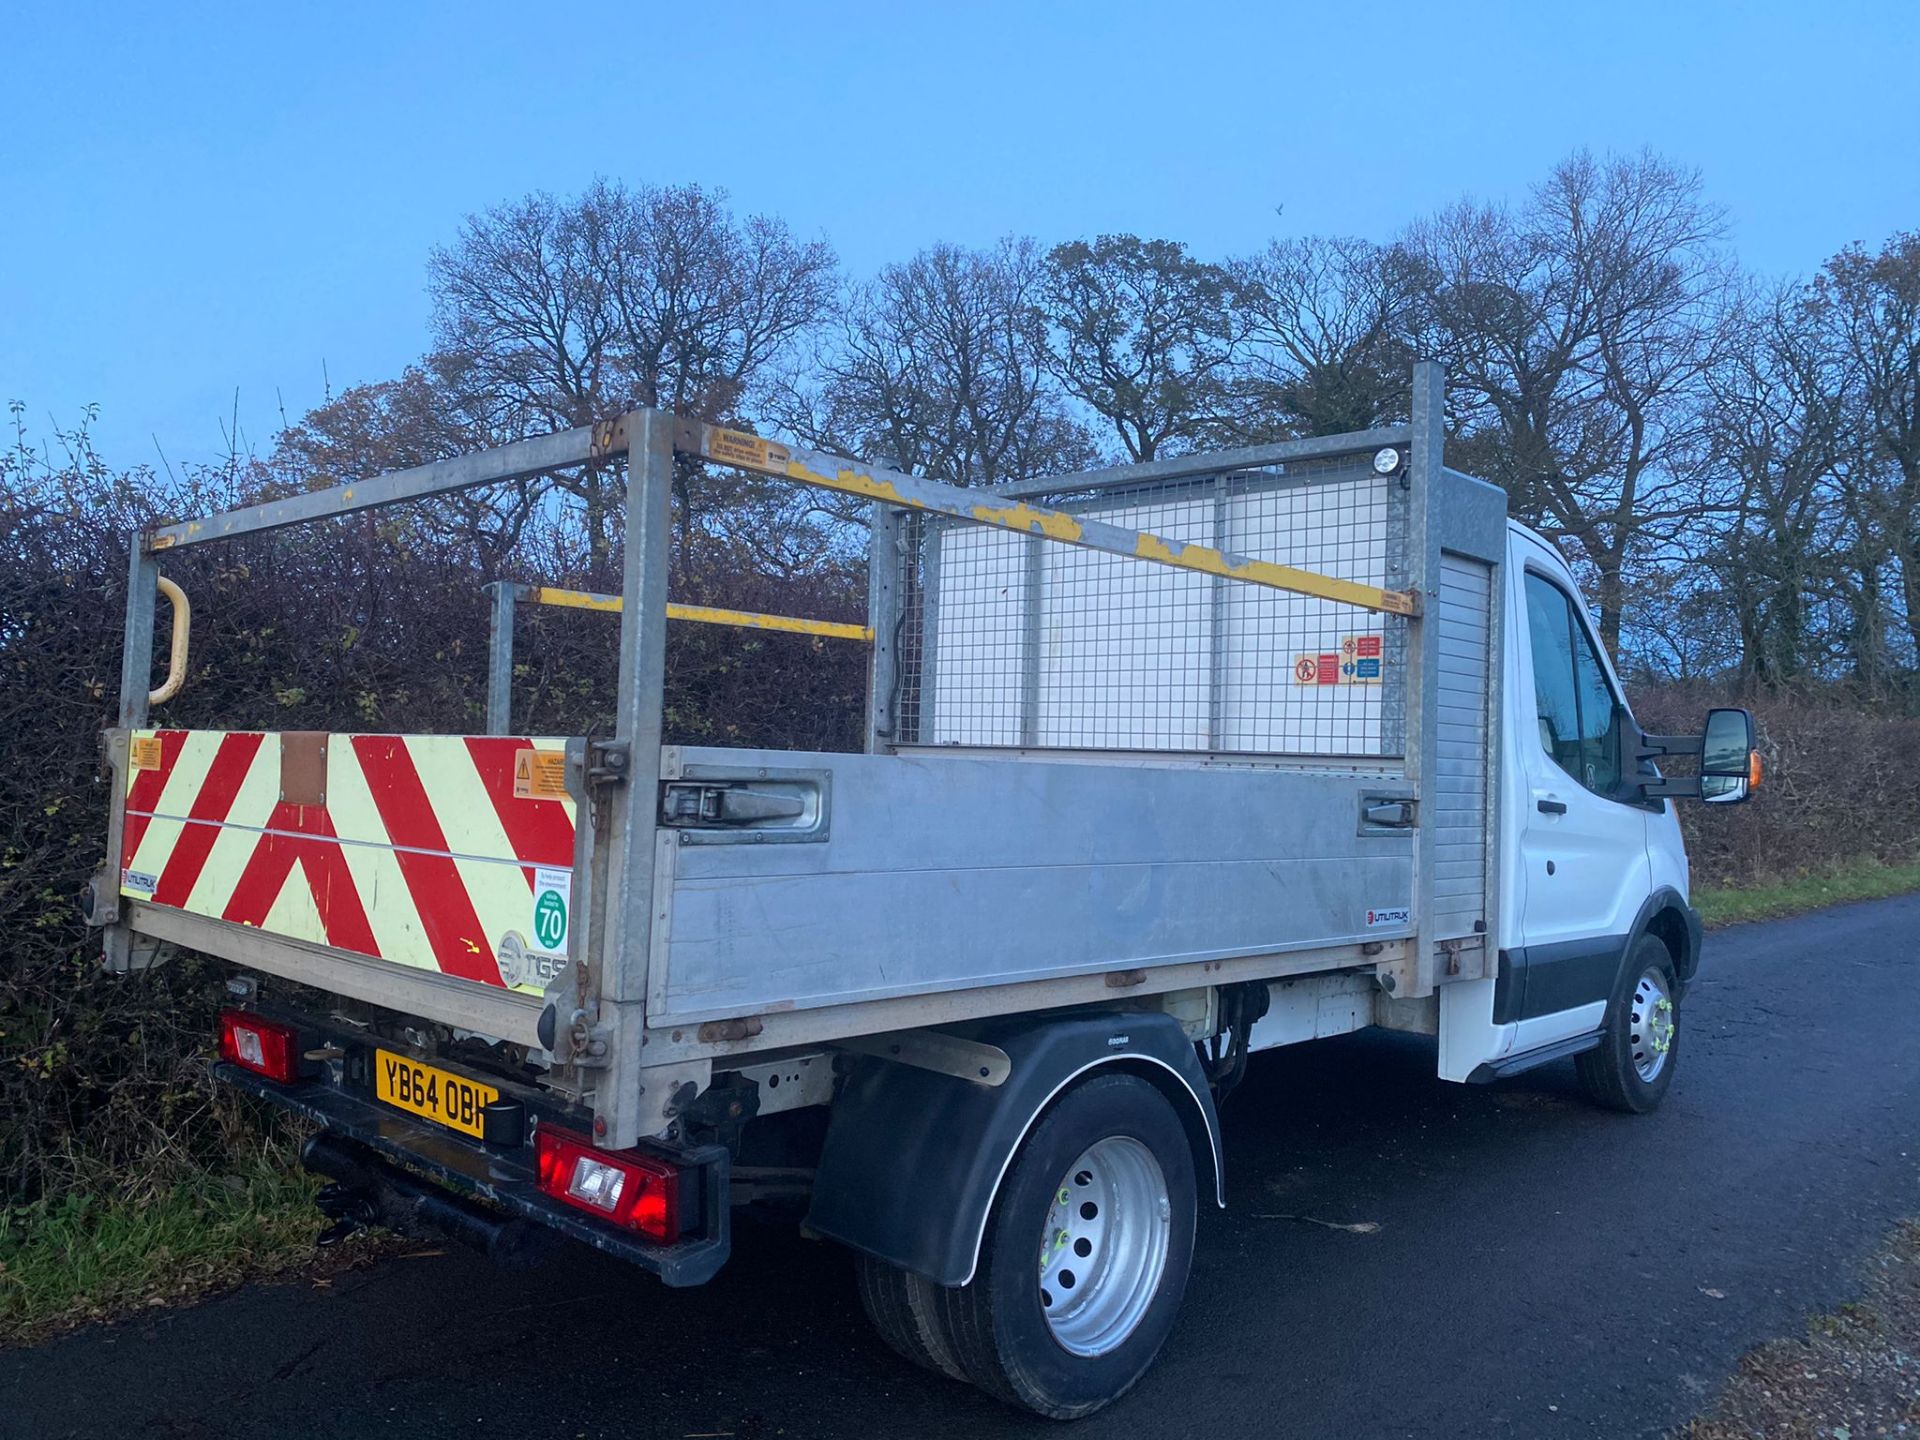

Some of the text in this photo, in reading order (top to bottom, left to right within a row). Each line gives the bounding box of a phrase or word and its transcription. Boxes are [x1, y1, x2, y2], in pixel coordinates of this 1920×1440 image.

[539, 908, 562, 940] 70
[385, 1058, 489, 1130] YB64 OBH
